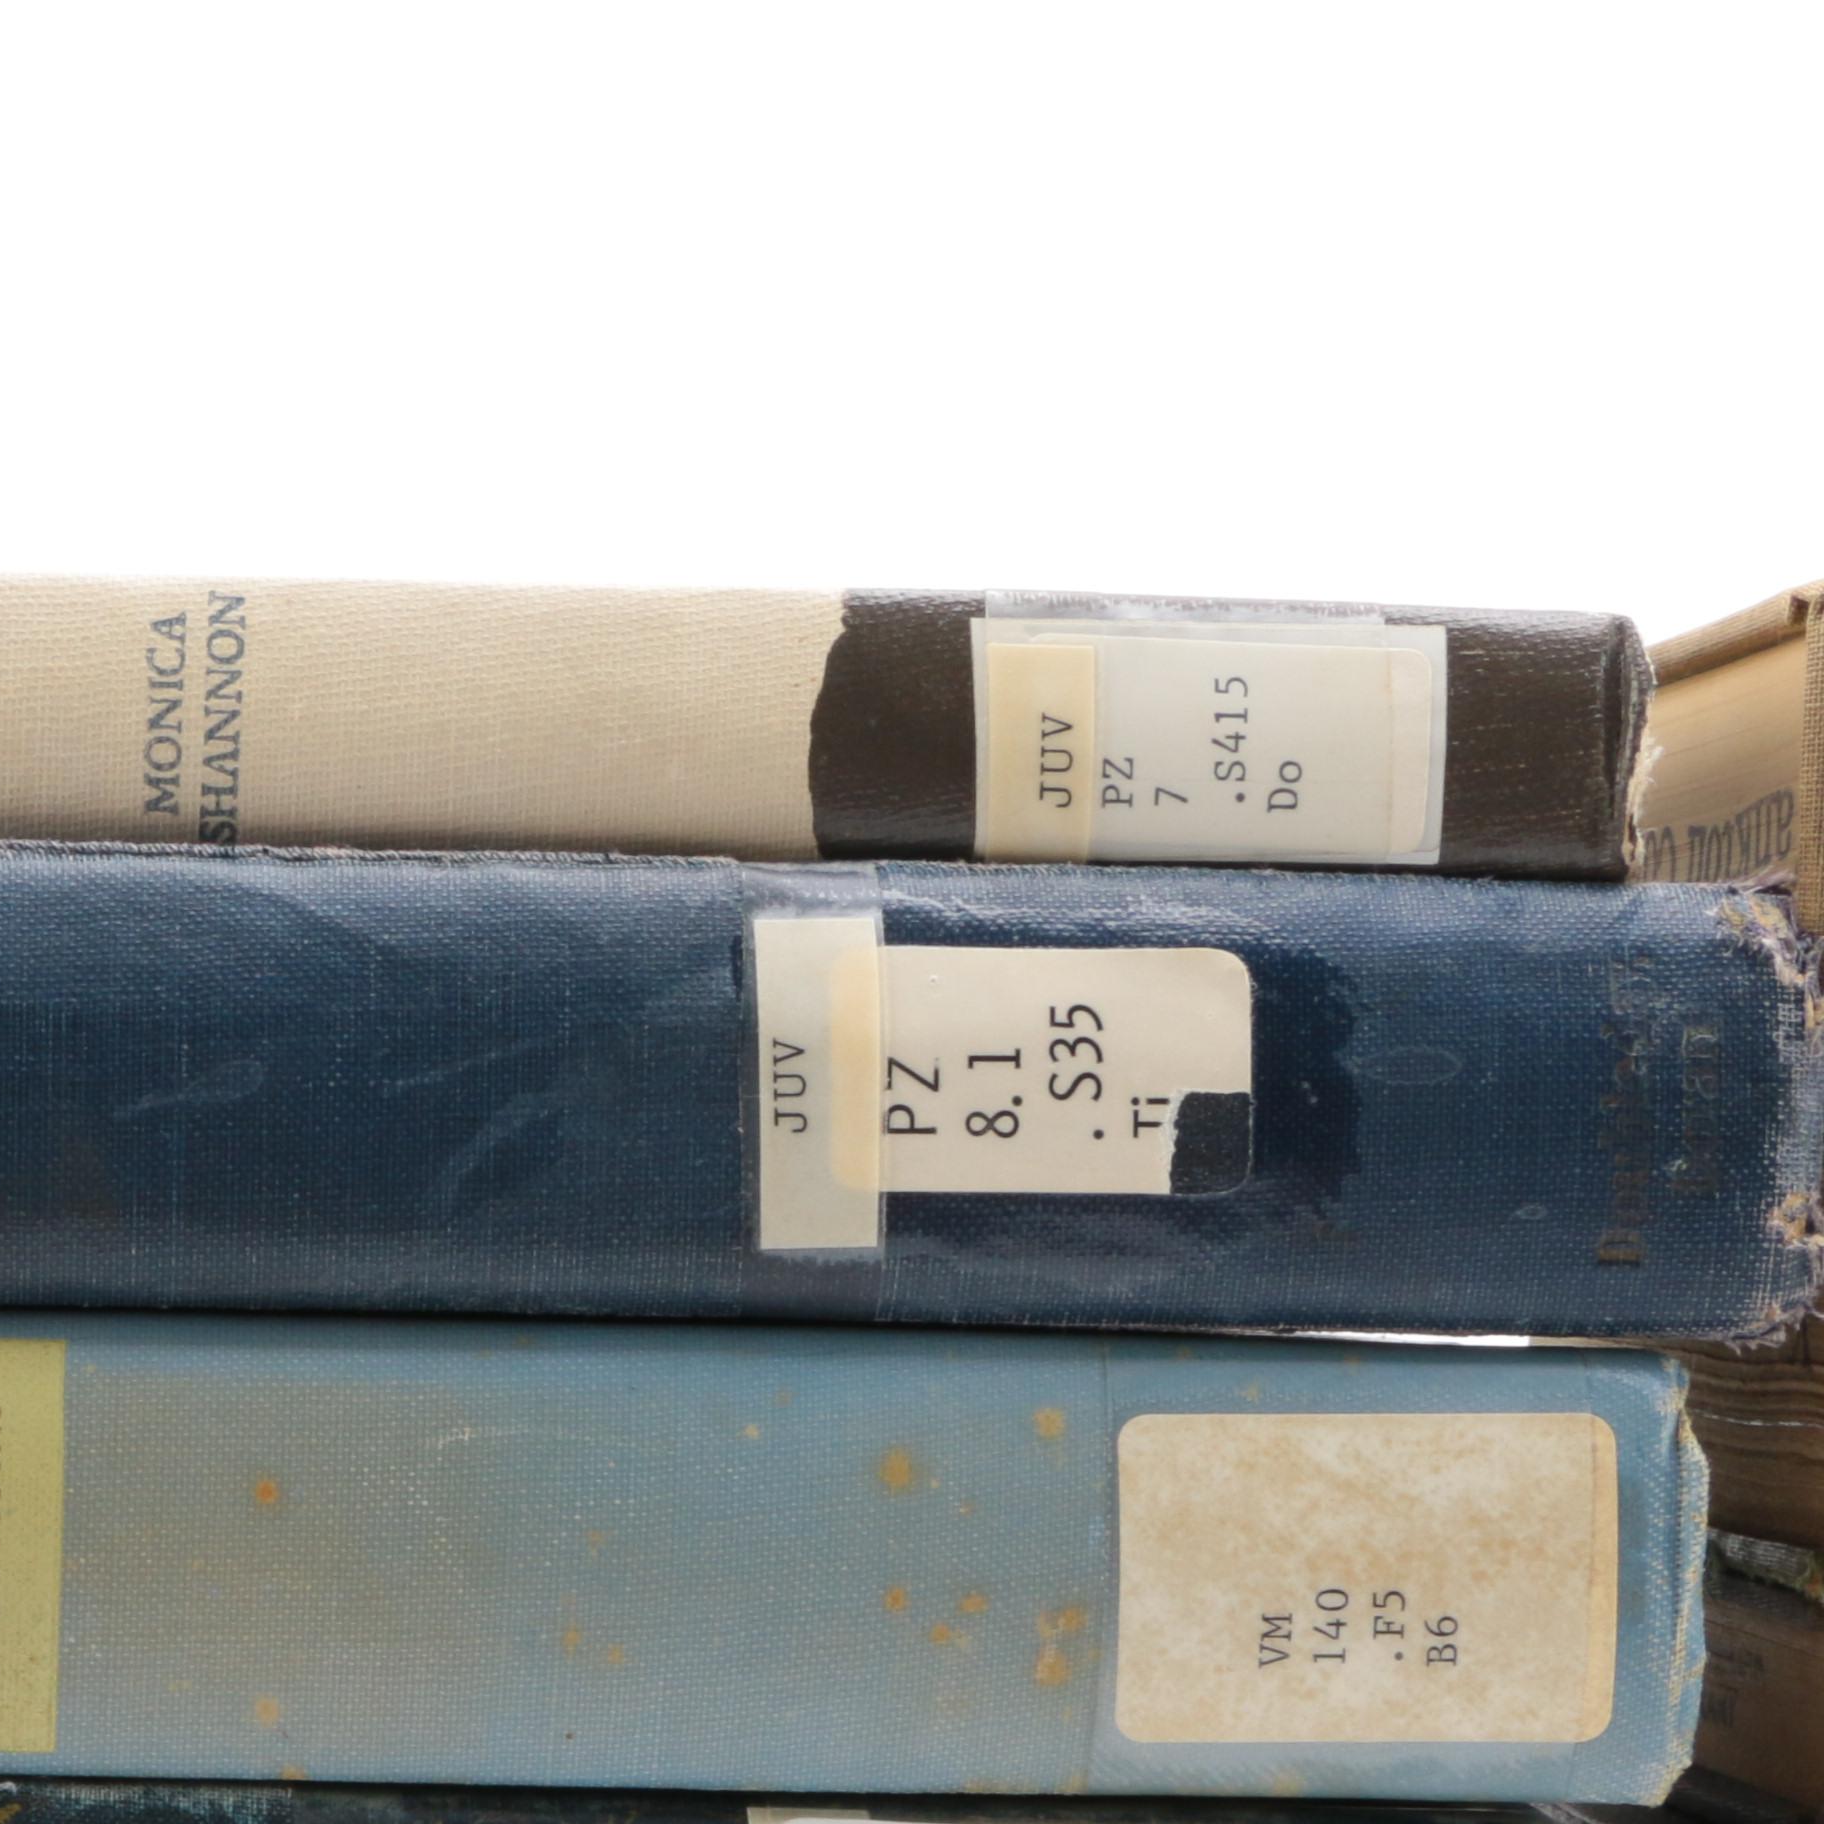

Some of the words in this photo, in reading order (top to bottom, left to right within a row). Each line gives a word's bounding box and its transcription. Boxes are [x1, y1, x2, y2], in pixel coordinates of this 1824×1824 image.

[143, 611, 187, 815] MONICA
[198, 590, 246, 848] SHANNON
[1212, 676, 1249, 803] .S415
[1038, 713, 1073, 808] JUV
[1102, 757, 1134, 808] PZ
[1155, 786, 1189, 806] 7
[1267, 760, 1303, 813] Do
[773, 1040, 807, 1134] JUV
[886, 1057, 939, 1136] PZ
[1258, 1612, 1293, 1669] VM
[1313, 1587, 1349, 1665] 140
[1373, 1588, 1406, 1662] .F5
[1426, 1614, 1459, 1667] B6
